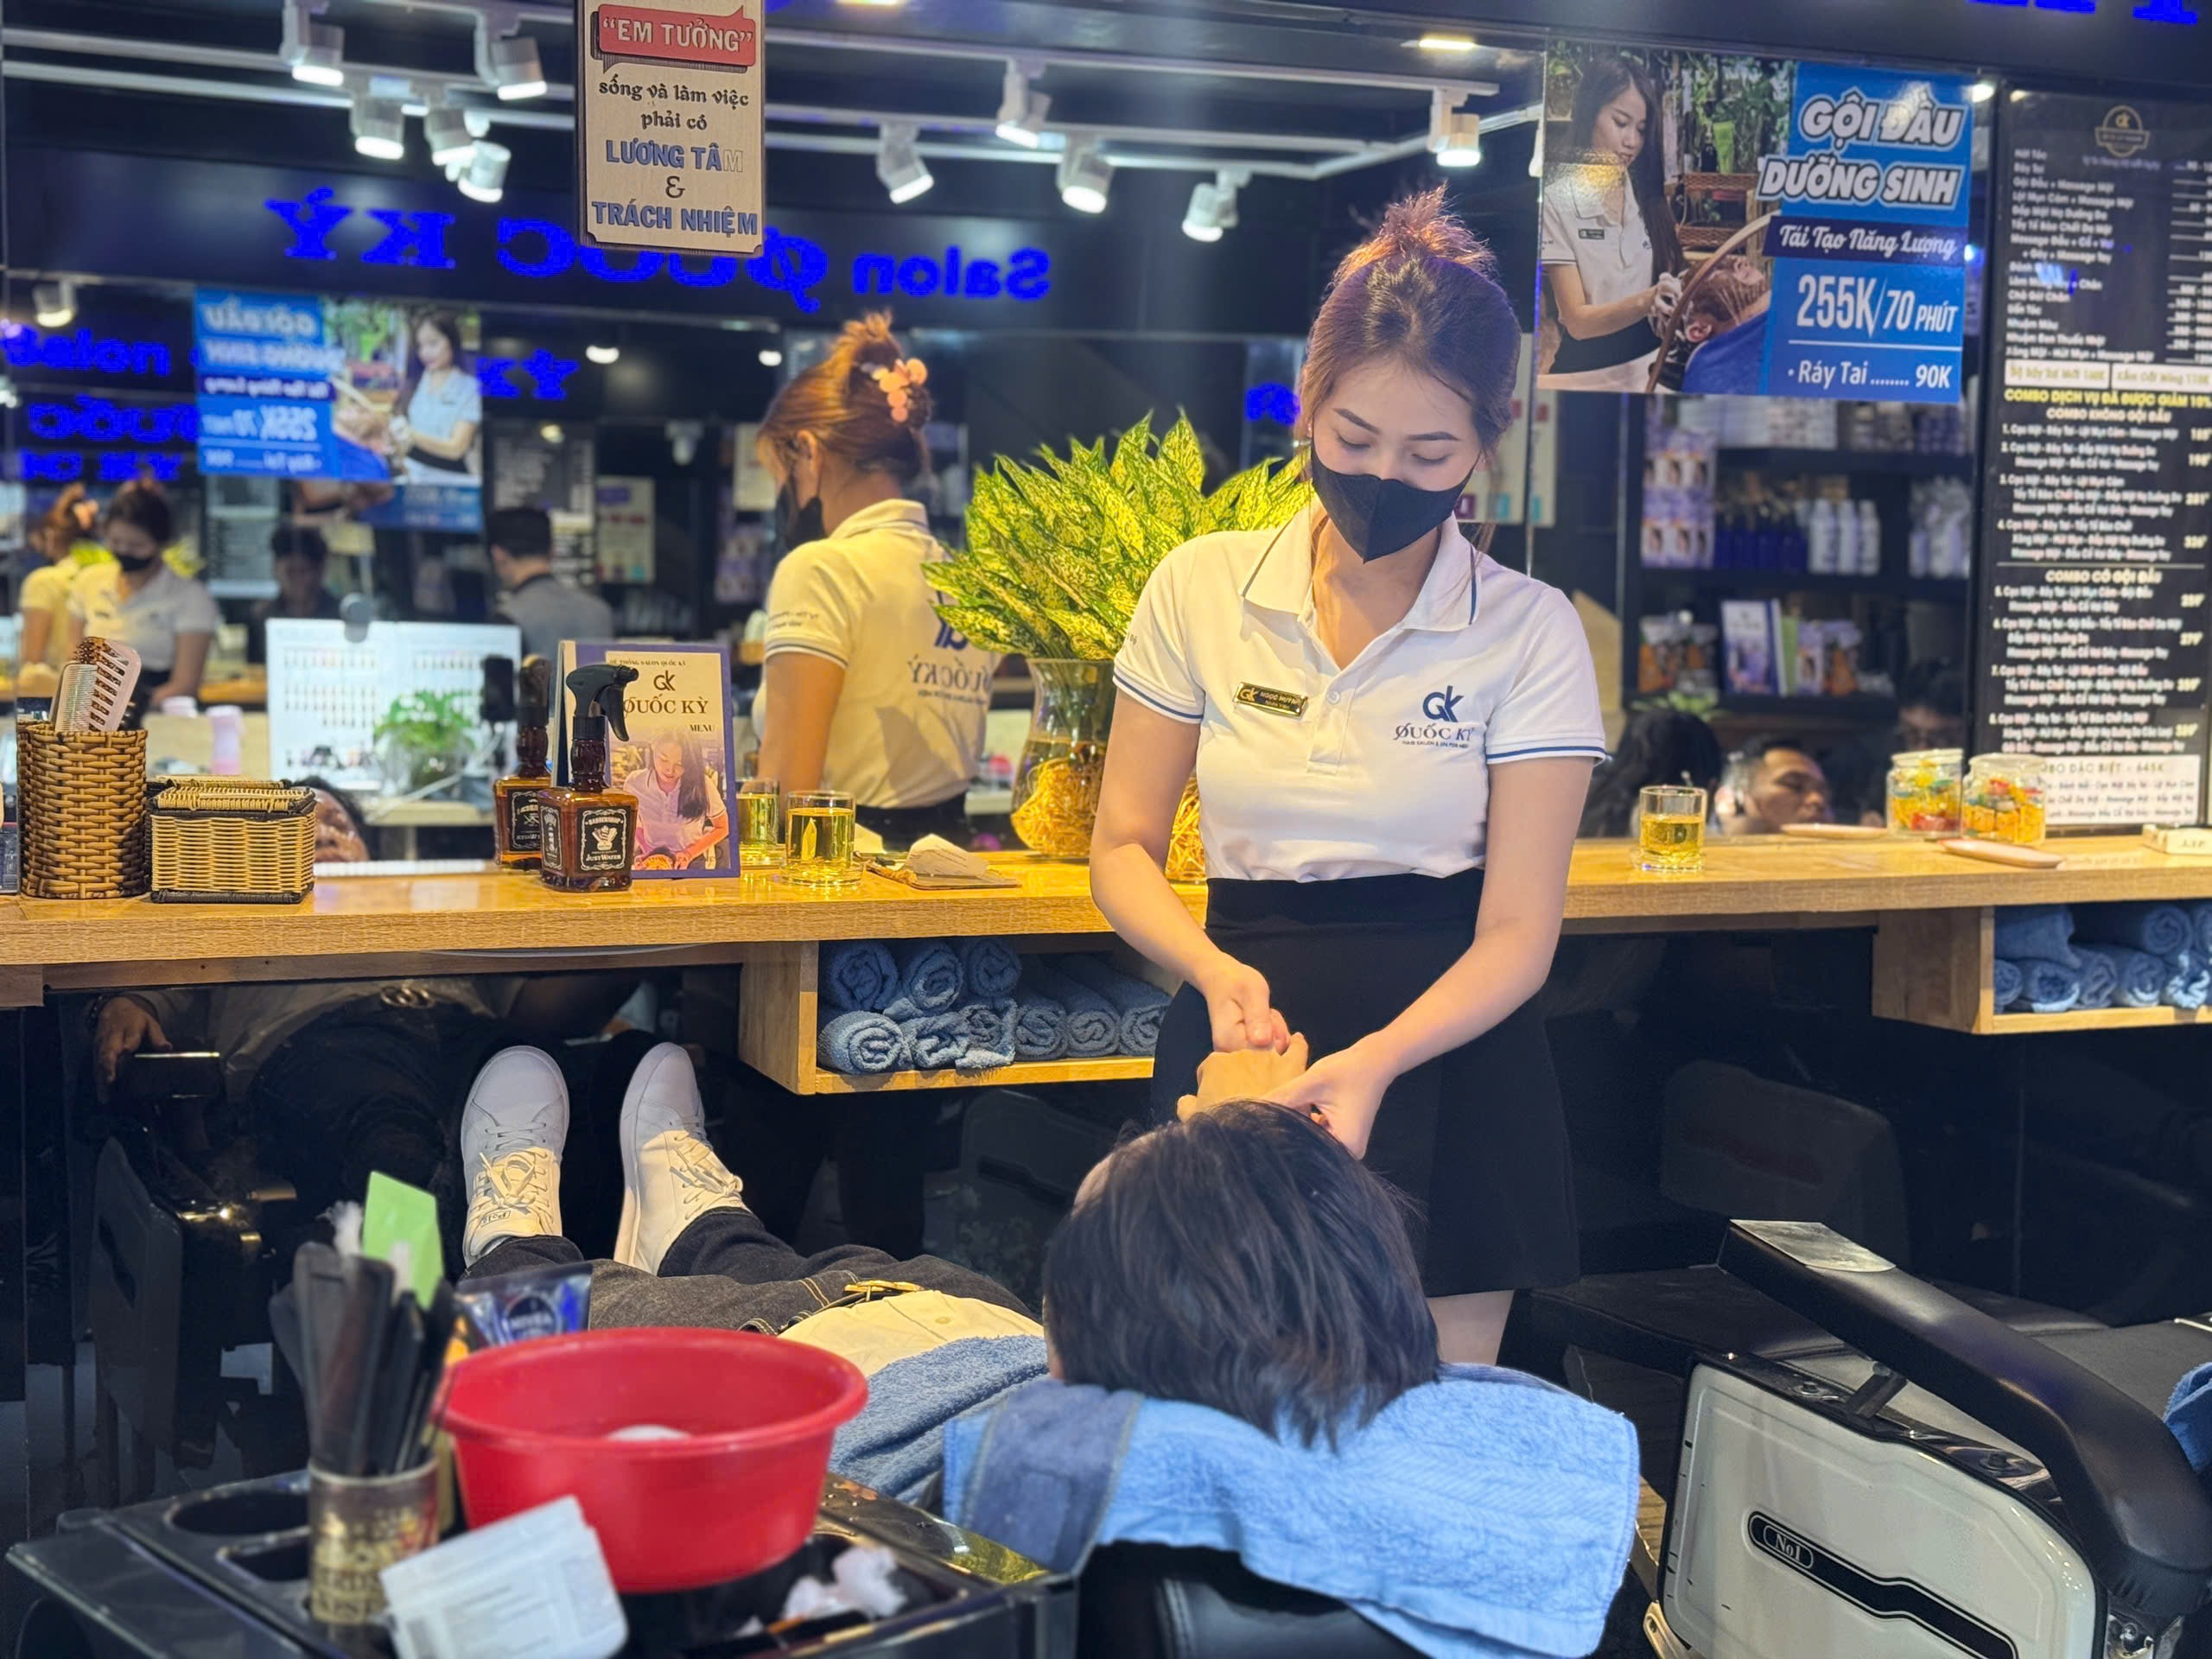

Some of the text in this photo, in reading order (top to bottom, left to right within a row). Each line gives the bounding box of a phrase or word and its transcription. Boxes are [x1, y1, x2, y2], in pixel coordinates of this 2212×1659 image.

[599, 73, 749, 110] sống và làm việc
[640, 111, 708, 130] phải có
[1801, 90, 1879, 150] GỘI
[606, 137, 685, 169] LƯƠNG
[664, 175, 686, 199] &
[1761, 153, 1960, 205] DƯỠNG SINH
[592, 199, 758, 238] TRÁCH NHIỆM
[1780, 224, 1957, 261] Tái Tạo Năng Lượng
[1916, 299, 1958, 334] PHÚT
[1798, 359, 1834, 390] Ráy
[1916, 365, 1952, 389] 90K
[690, 724, 715, 733] MENU
